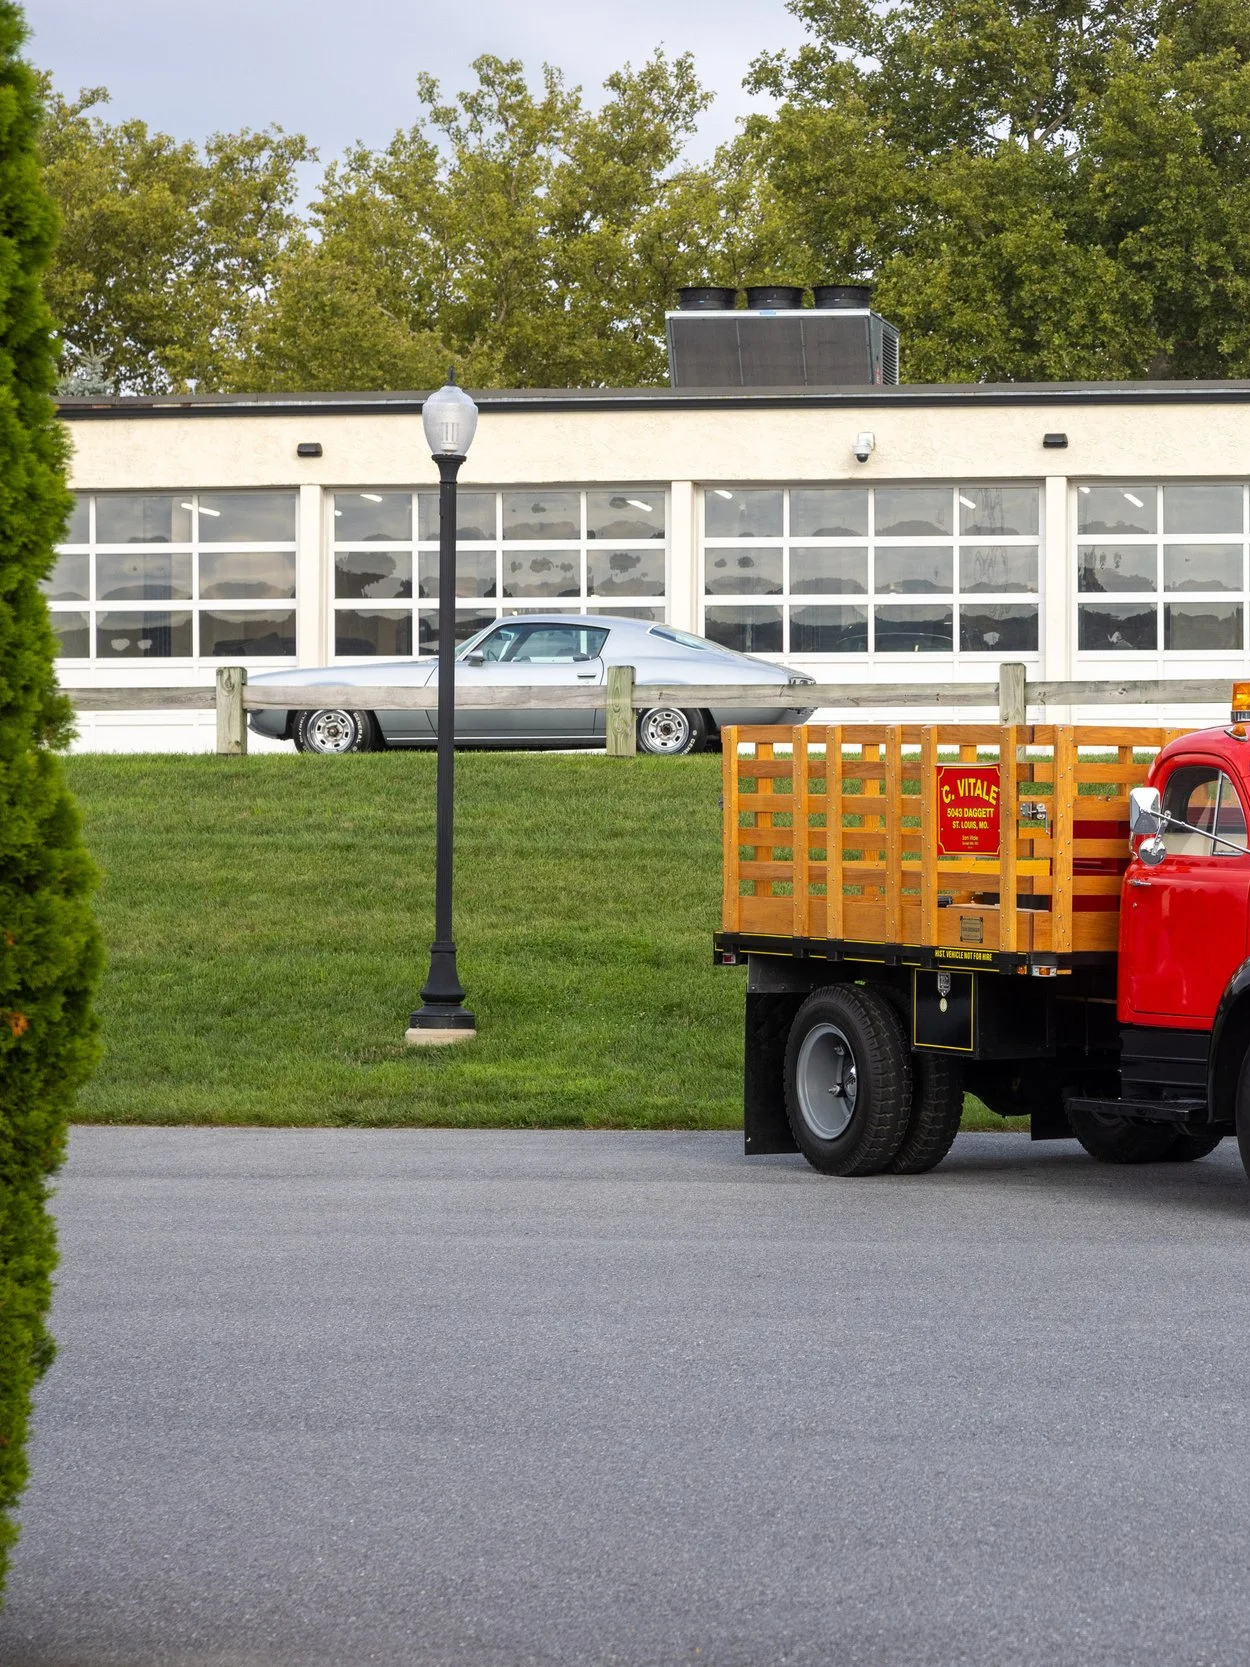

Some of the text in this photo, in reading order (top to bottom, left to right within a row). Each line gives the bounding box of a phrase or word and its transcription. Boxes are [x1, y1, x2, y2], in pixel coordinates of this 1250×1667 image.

[353, 712, 363, 744] GENERAL
[942, 778, 999, 806] C. VITALE
[947, 808, 994, 818] 5043 DAGGETT
[952, 820, 989, 830] ST. LOUIS, MO.
[946, 950, 964, 960] VEHICLE
[964, 951, 973, 960] NOT
[973, 952, 981, 960] FOR
[982, 953, 993, 961] HIRE
